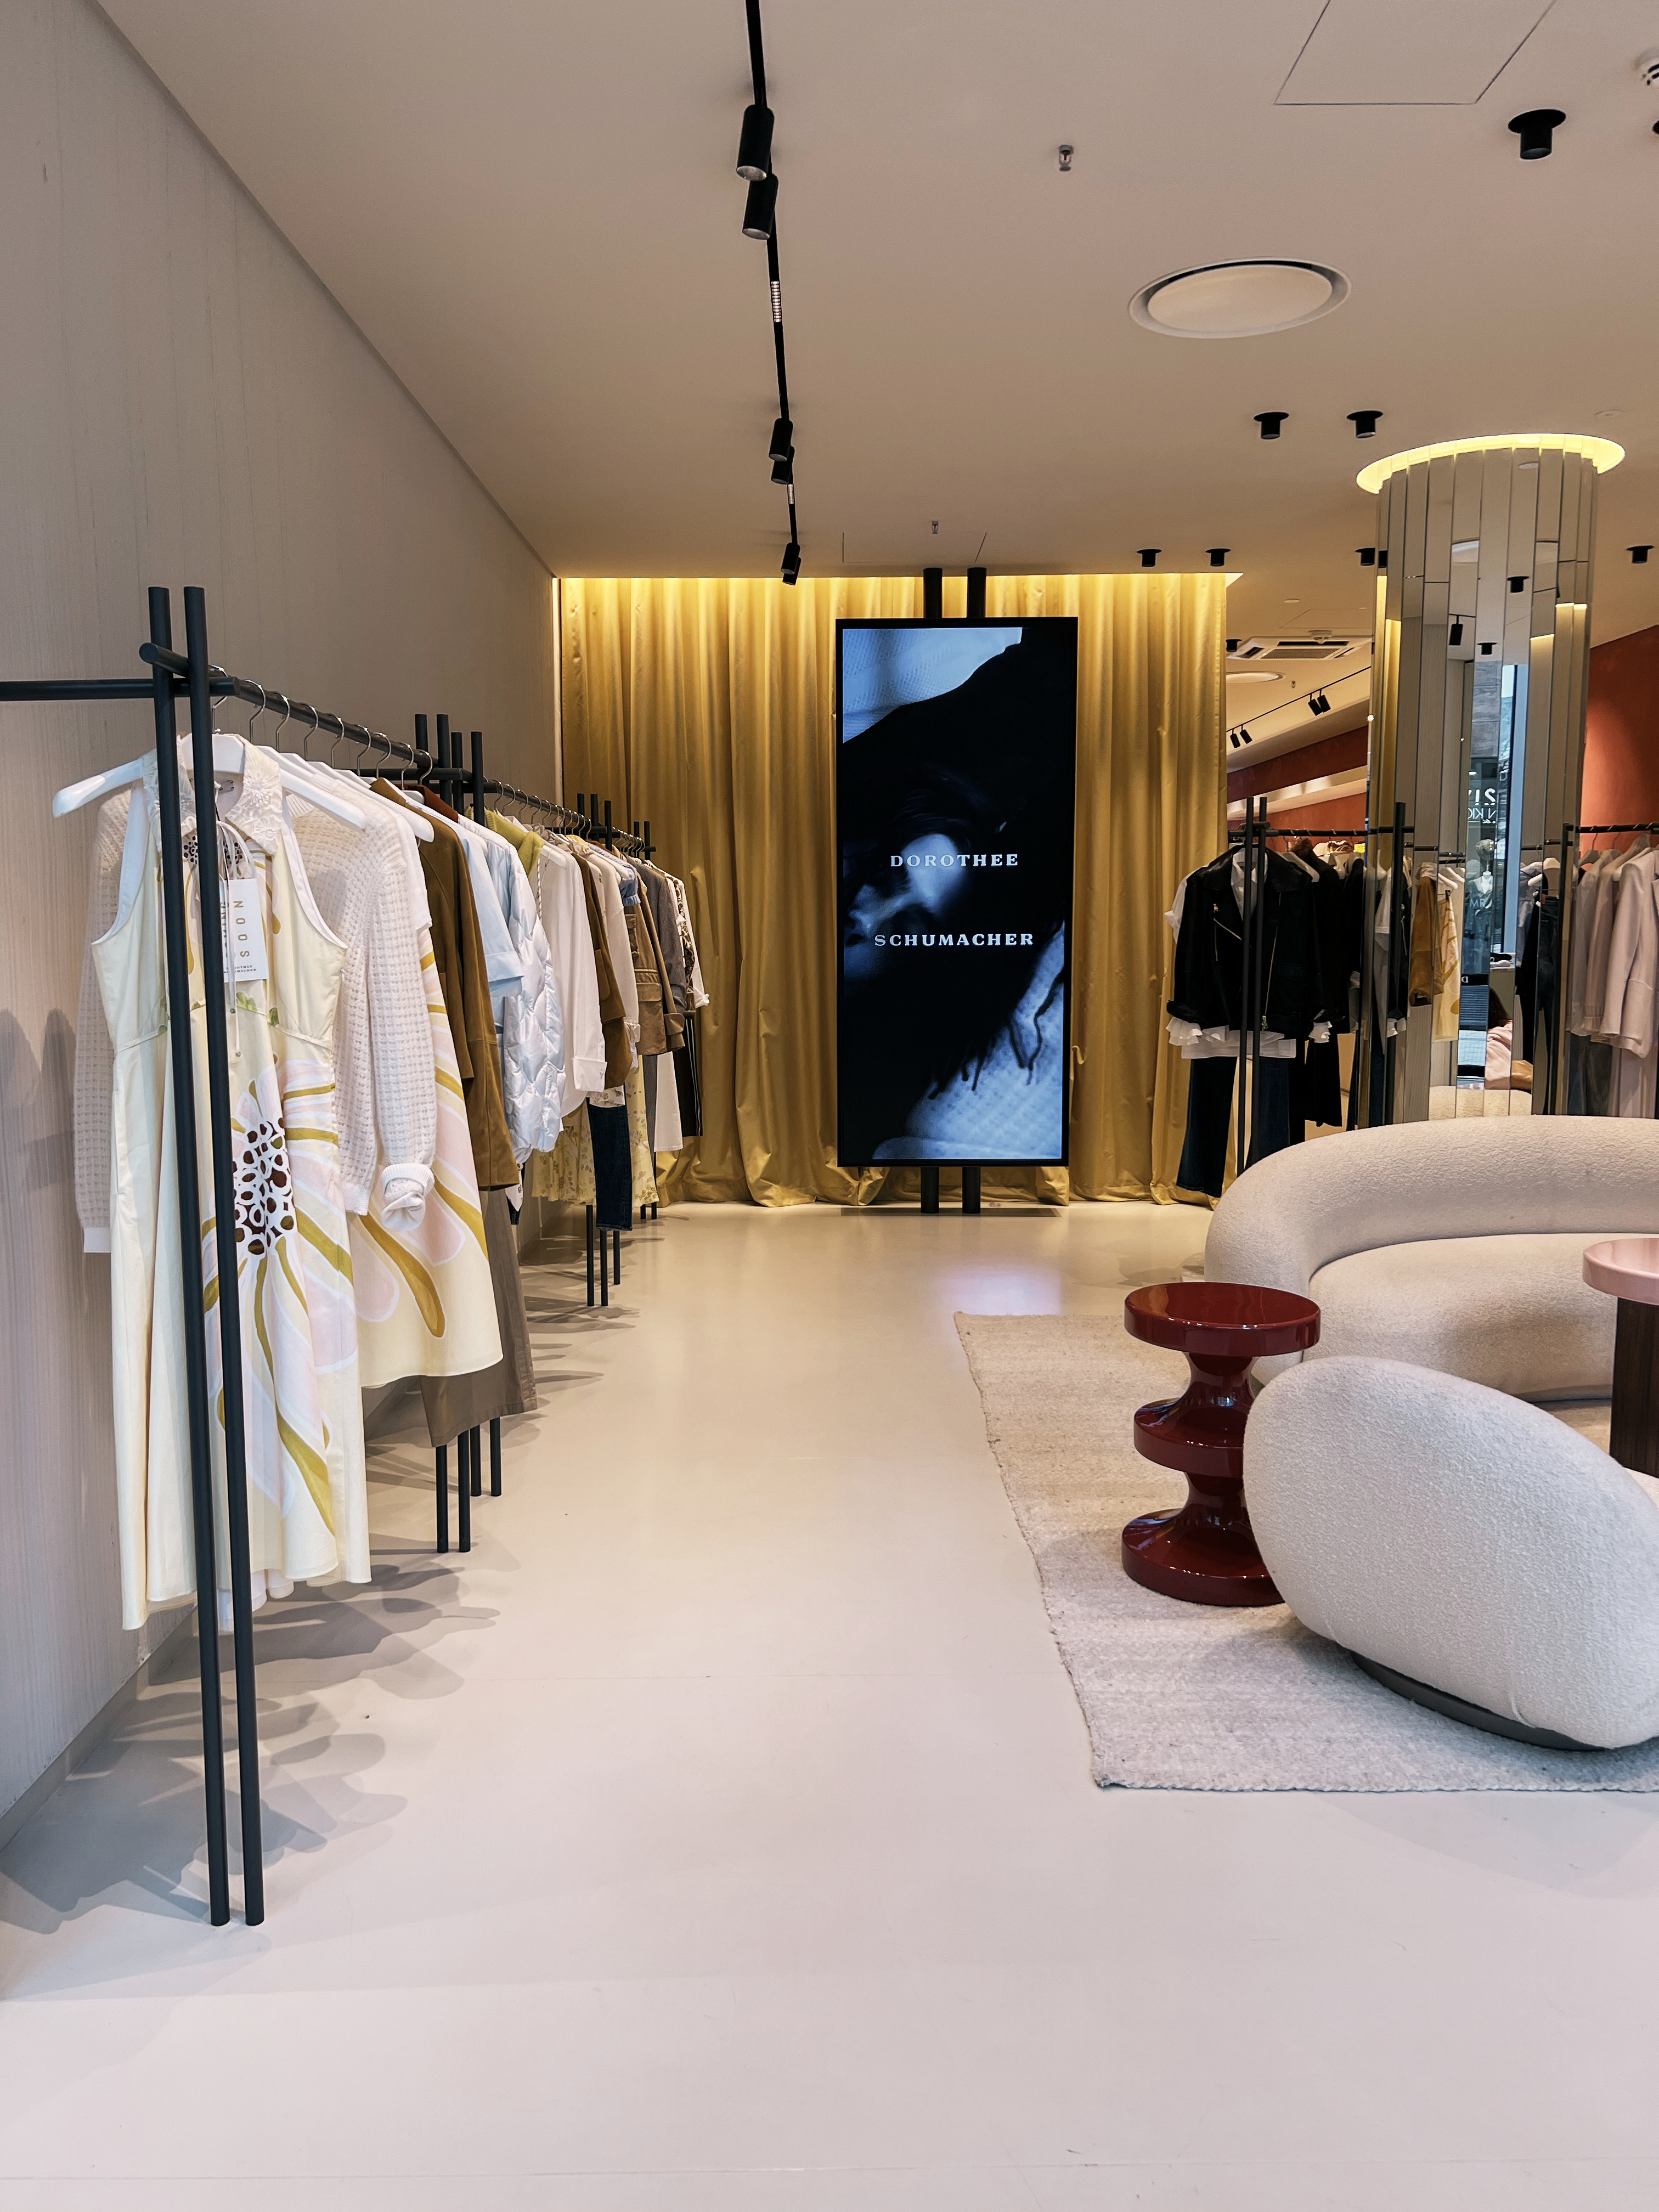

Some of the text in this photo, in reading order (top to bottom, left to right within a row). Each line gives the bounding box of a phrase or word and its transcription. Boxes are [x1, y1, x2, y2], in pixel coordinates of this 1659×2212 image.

[890, 854, 1018, 867] DOROTHEE
[233, 900, 250, 958] NOOS
[874, 933, 1034, 947] SCHUMACHER
